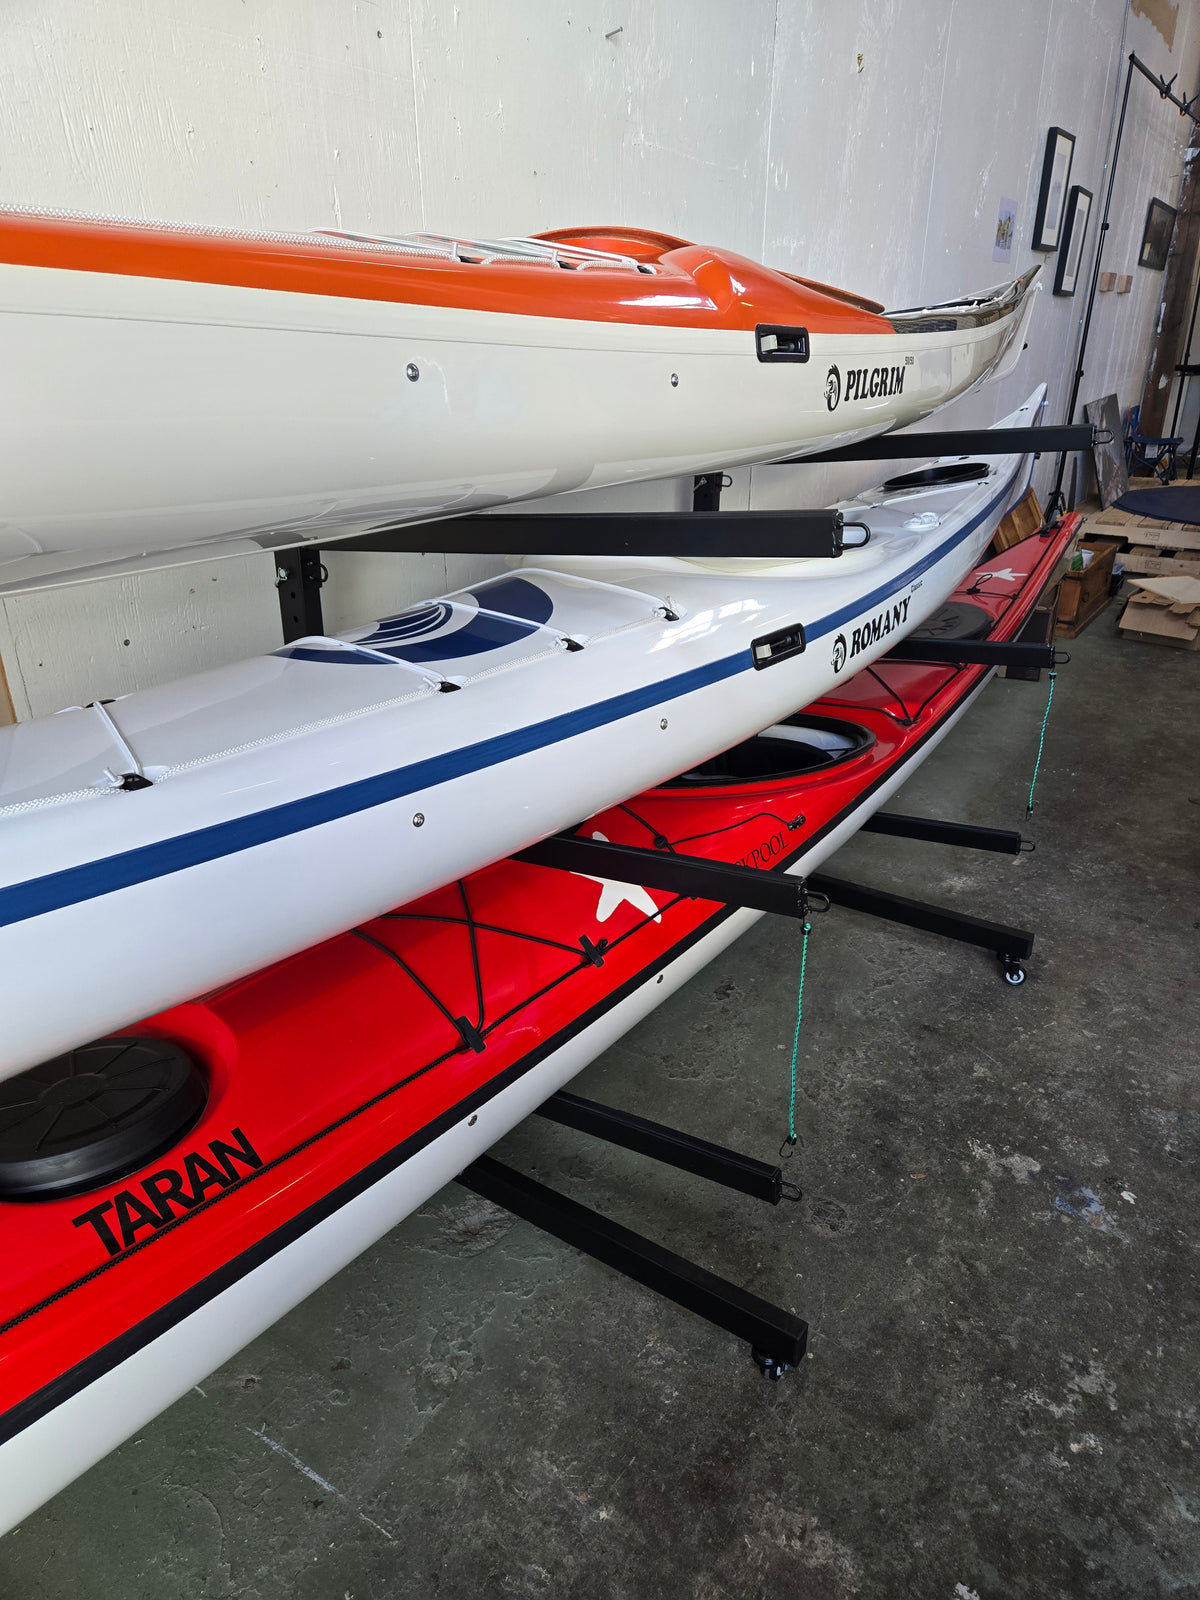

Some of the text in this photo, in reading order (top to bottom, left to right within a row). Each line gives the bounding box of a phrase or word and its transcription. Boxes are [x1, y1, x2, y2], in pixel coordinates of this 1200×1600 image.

[844, 366, 905, 401] PILGRIM
[850, 595, 911, 658] ROMANY
[71, 1127, 264, 1256] TARAN
